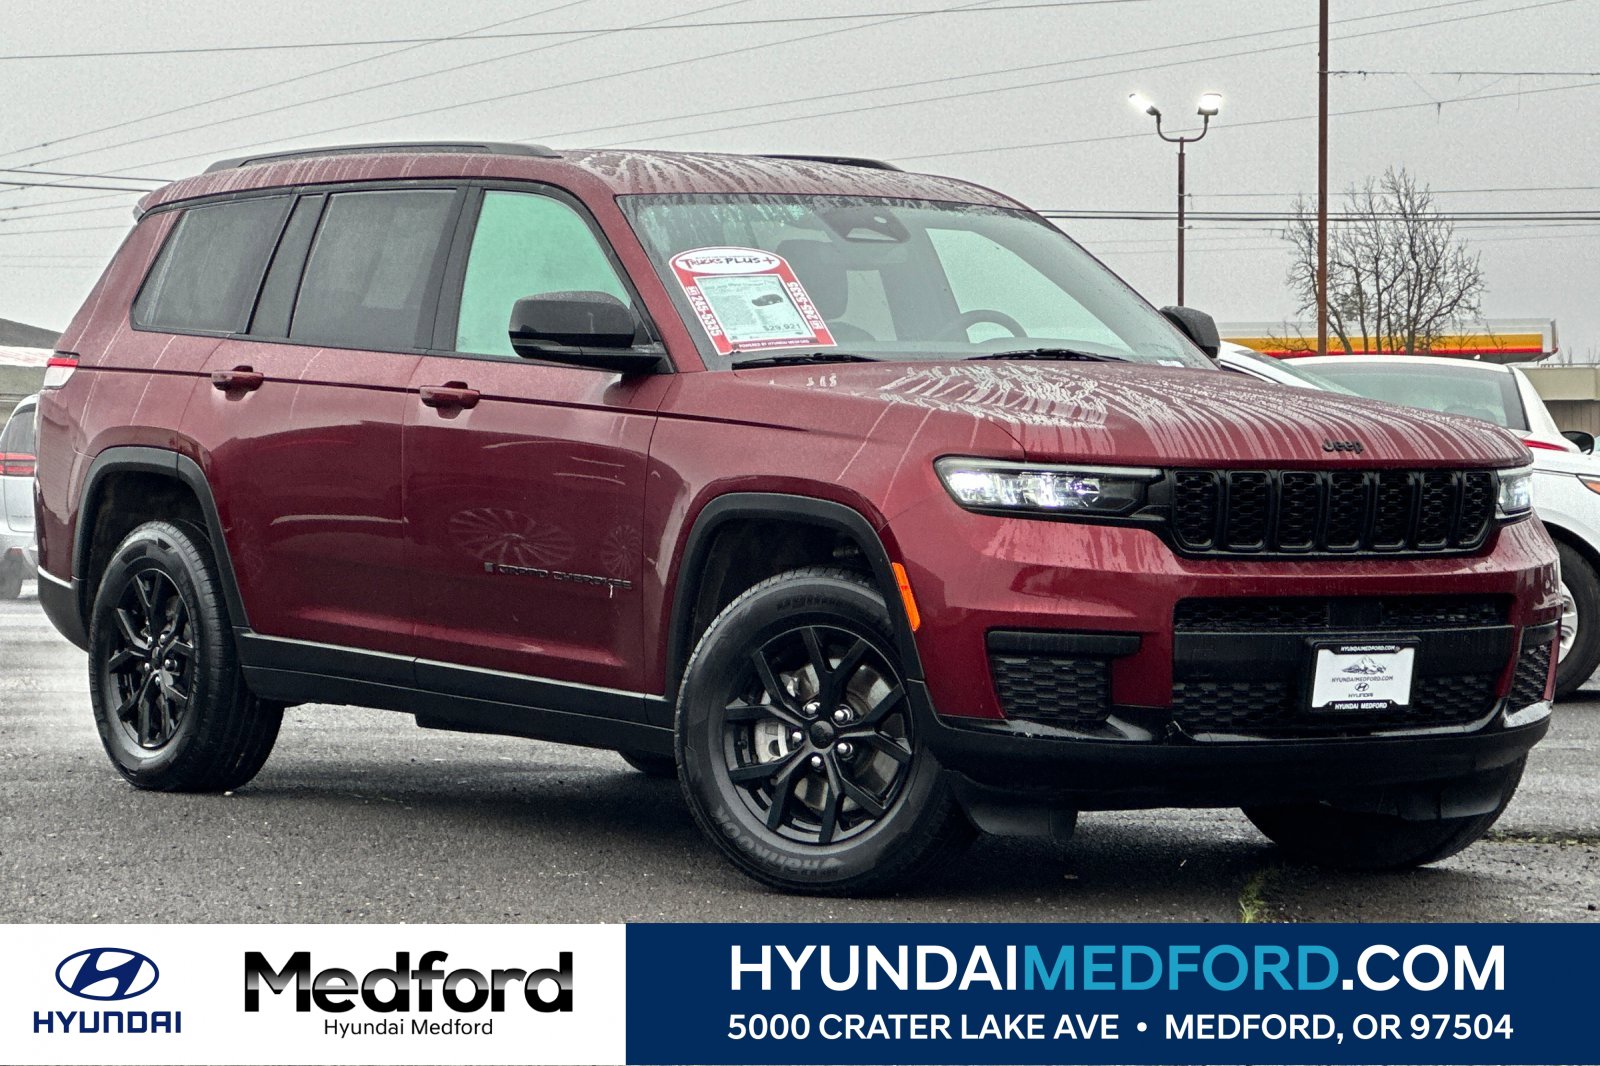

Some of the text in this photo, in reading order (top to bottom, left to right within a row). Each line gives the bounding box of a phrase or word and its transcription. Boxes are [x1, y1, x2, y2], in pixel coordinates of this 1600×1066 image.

[725, 257, 761, 265] PLUS
[691, 295, 723, 336] 245-5335
[1322, 439, 1364, 454] Jeep
[1332, 675, 1394, 683] HYUNDAIMEDFORD.COM
